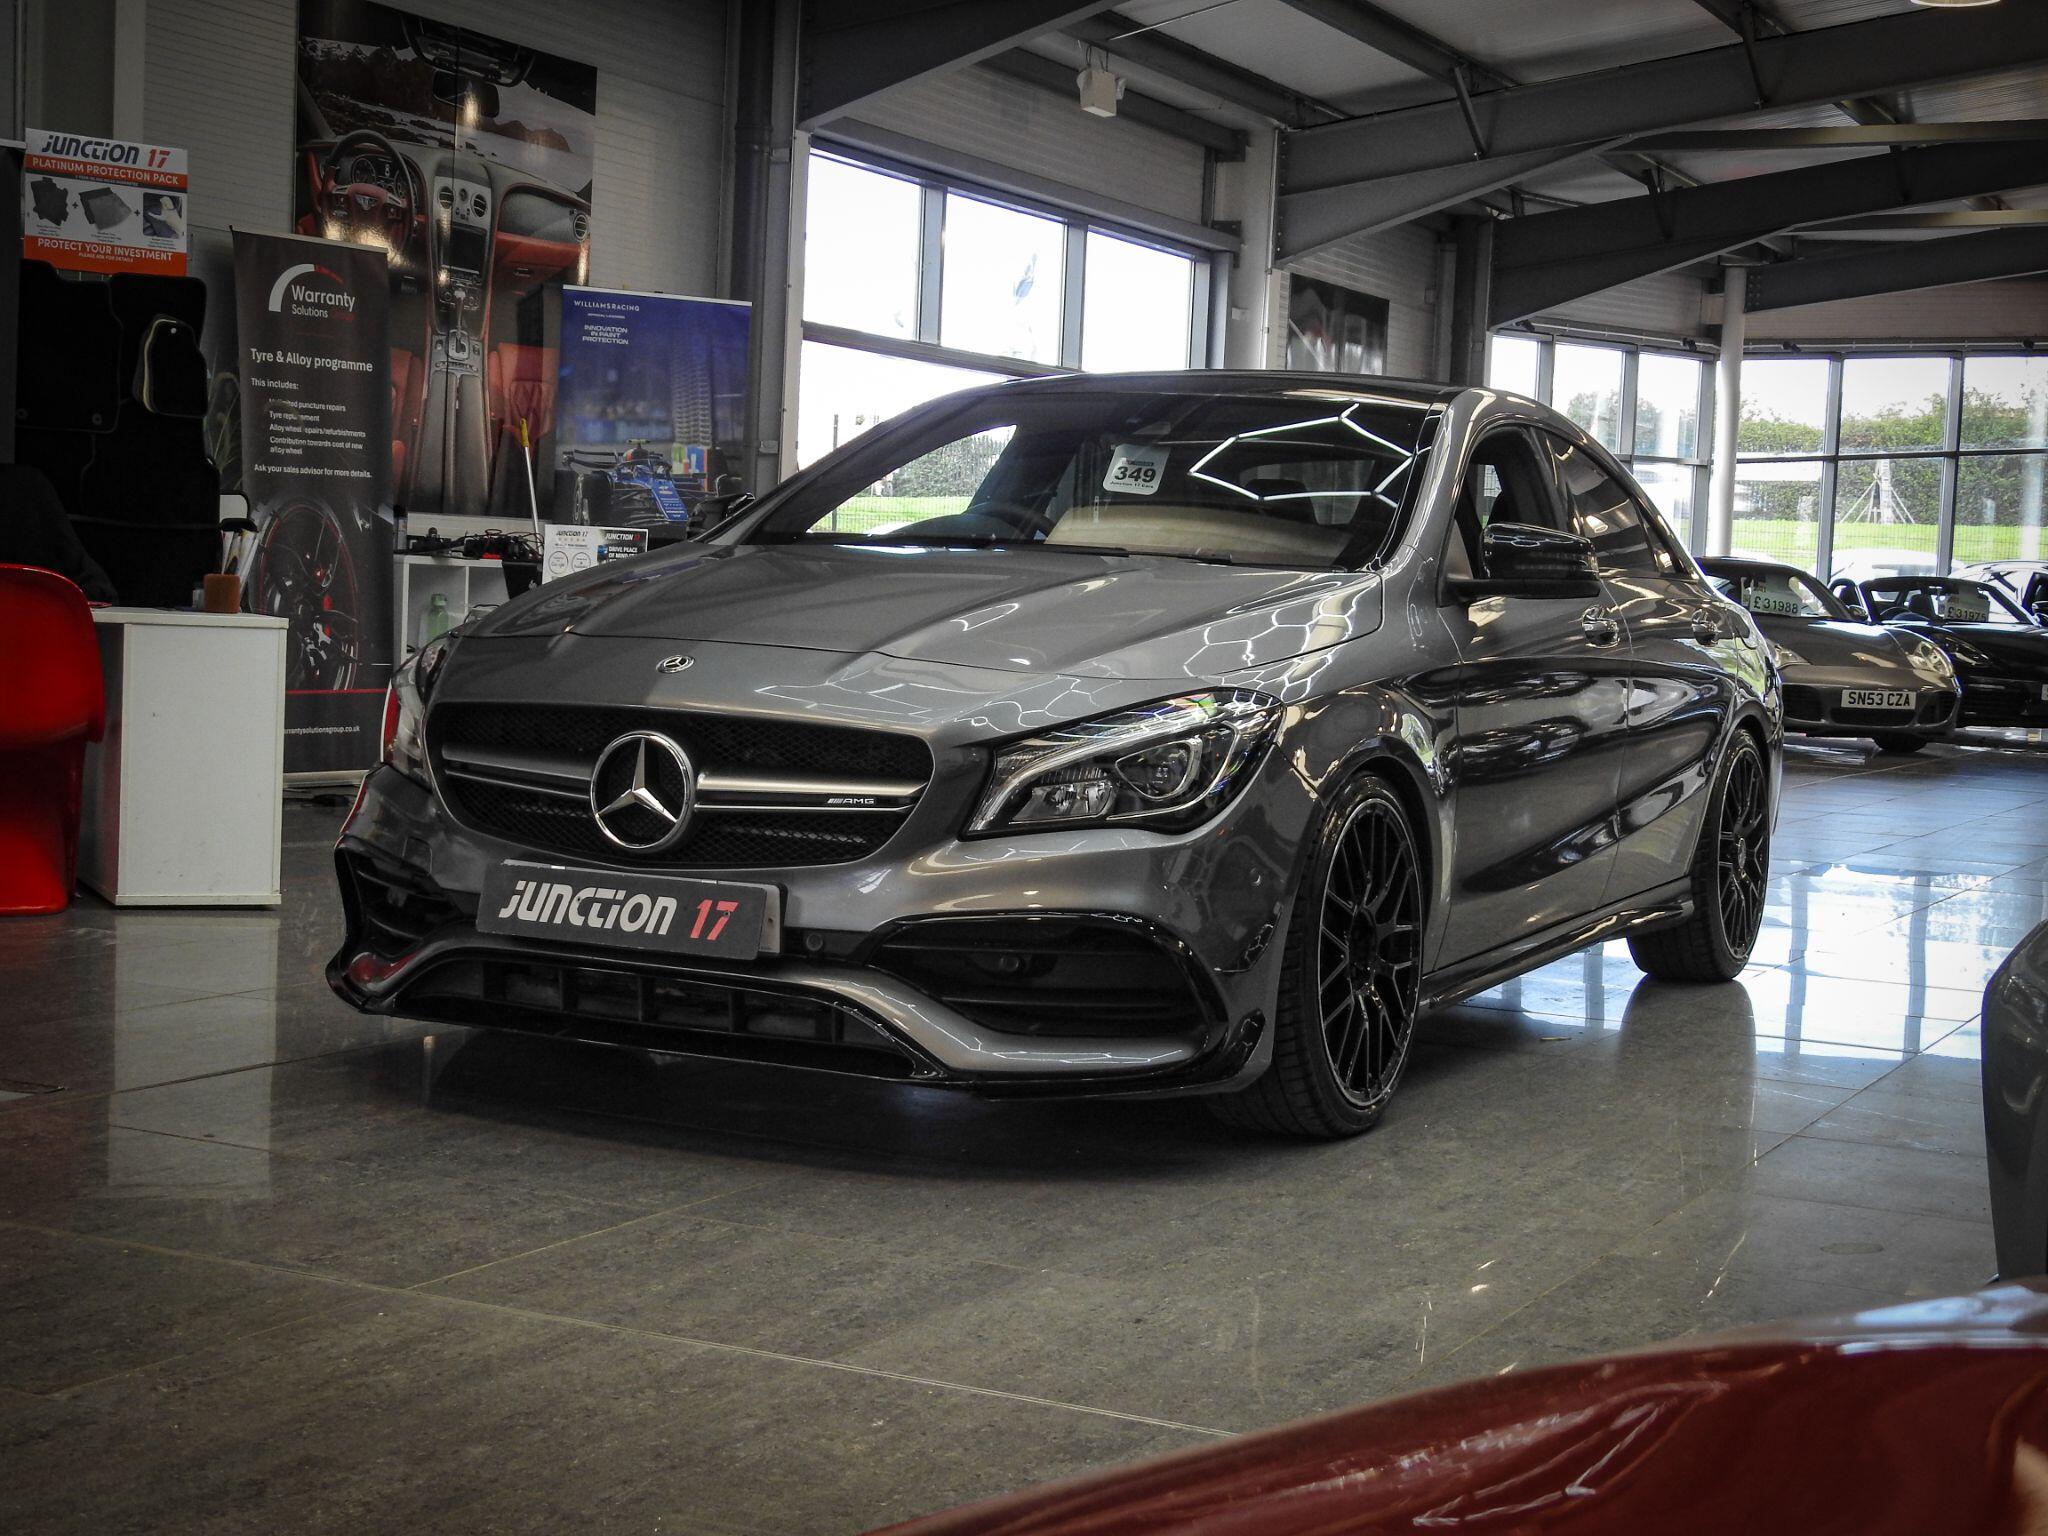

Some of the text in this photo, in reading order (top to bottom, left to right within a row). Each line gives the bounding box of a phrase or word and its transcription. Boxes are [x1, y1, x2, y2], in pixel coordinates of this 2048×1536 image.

[148, 149, 171, 168] 17
[32, 157, 85, 172] PLATINUM
[86, 166, 150, 182] PROTECTION
[153, 174, 179, 185] PACK
[38, 238, 173, 262] PROTECT YOUR INVESTMENT
[291, 284, 356, 312] Warranty
[292, 304, 328, 318] Solutions
[574, 300, 640, 312] WILLIAMS RACING
[584, 324, 628, 334] INNOVATION
[582, 336, 630, 344] PROTECTION
[250, 348, 373, 372] Tyre & Alloy programme
[251, 378, 300, 390] This includes:
[269, 410, 282, 420] Tyre
[270, 424, 284, 432] Alloy
[270, 436, 306, 444] Contribution
[307, 439, 331, 447] towards
[254, 464, 268, 472] Ask
[268, 465, 282, 473] your
[283, 466, 299, 474] sales
[300, 466, 324, 475] advisor
[324, 466, 333, 475] for
[334, 468, 350, 476] more
[1114, 466, 1156, 483] 349
[1848, 692, 1910, 706] SN53 CZA
[689, 898, 740, 941] 17
